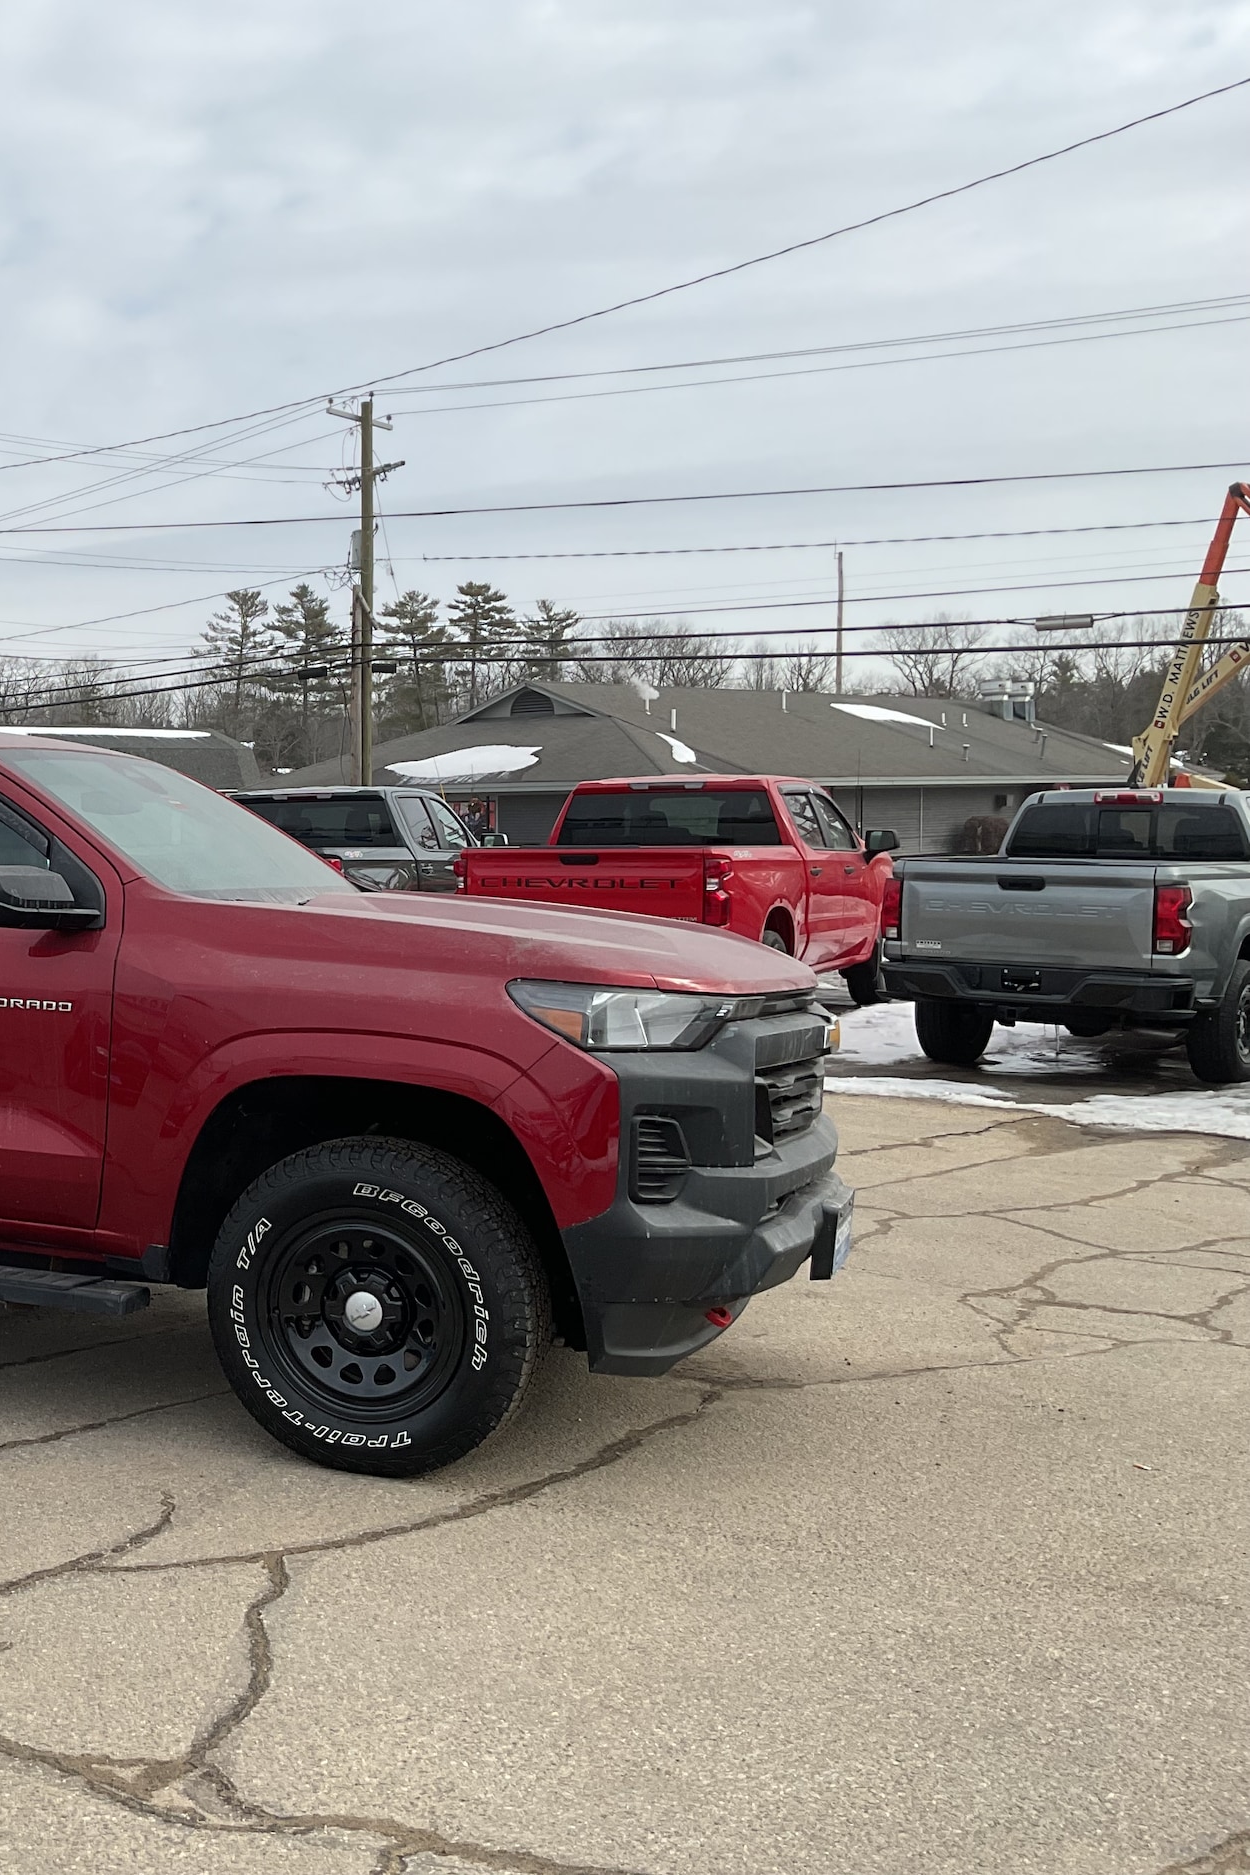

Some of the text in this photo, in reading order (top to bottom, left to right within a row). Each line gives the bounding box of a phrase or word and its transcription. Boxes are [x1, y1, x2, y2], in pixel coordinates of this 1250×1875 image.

[1202, 669, 1220, 690] LIFT
[1157, 691, 1175, 719] W.D.
[480, 876, 684, 890] CHEVROLET
[925, 899, 1122, 918] CHEVROLET
[236, 1217, 272, 1270] T/A
[353, 1182, 490, 1371] BFGoodrich
[229, 1284, 412, 1448] Trail-Terrain
